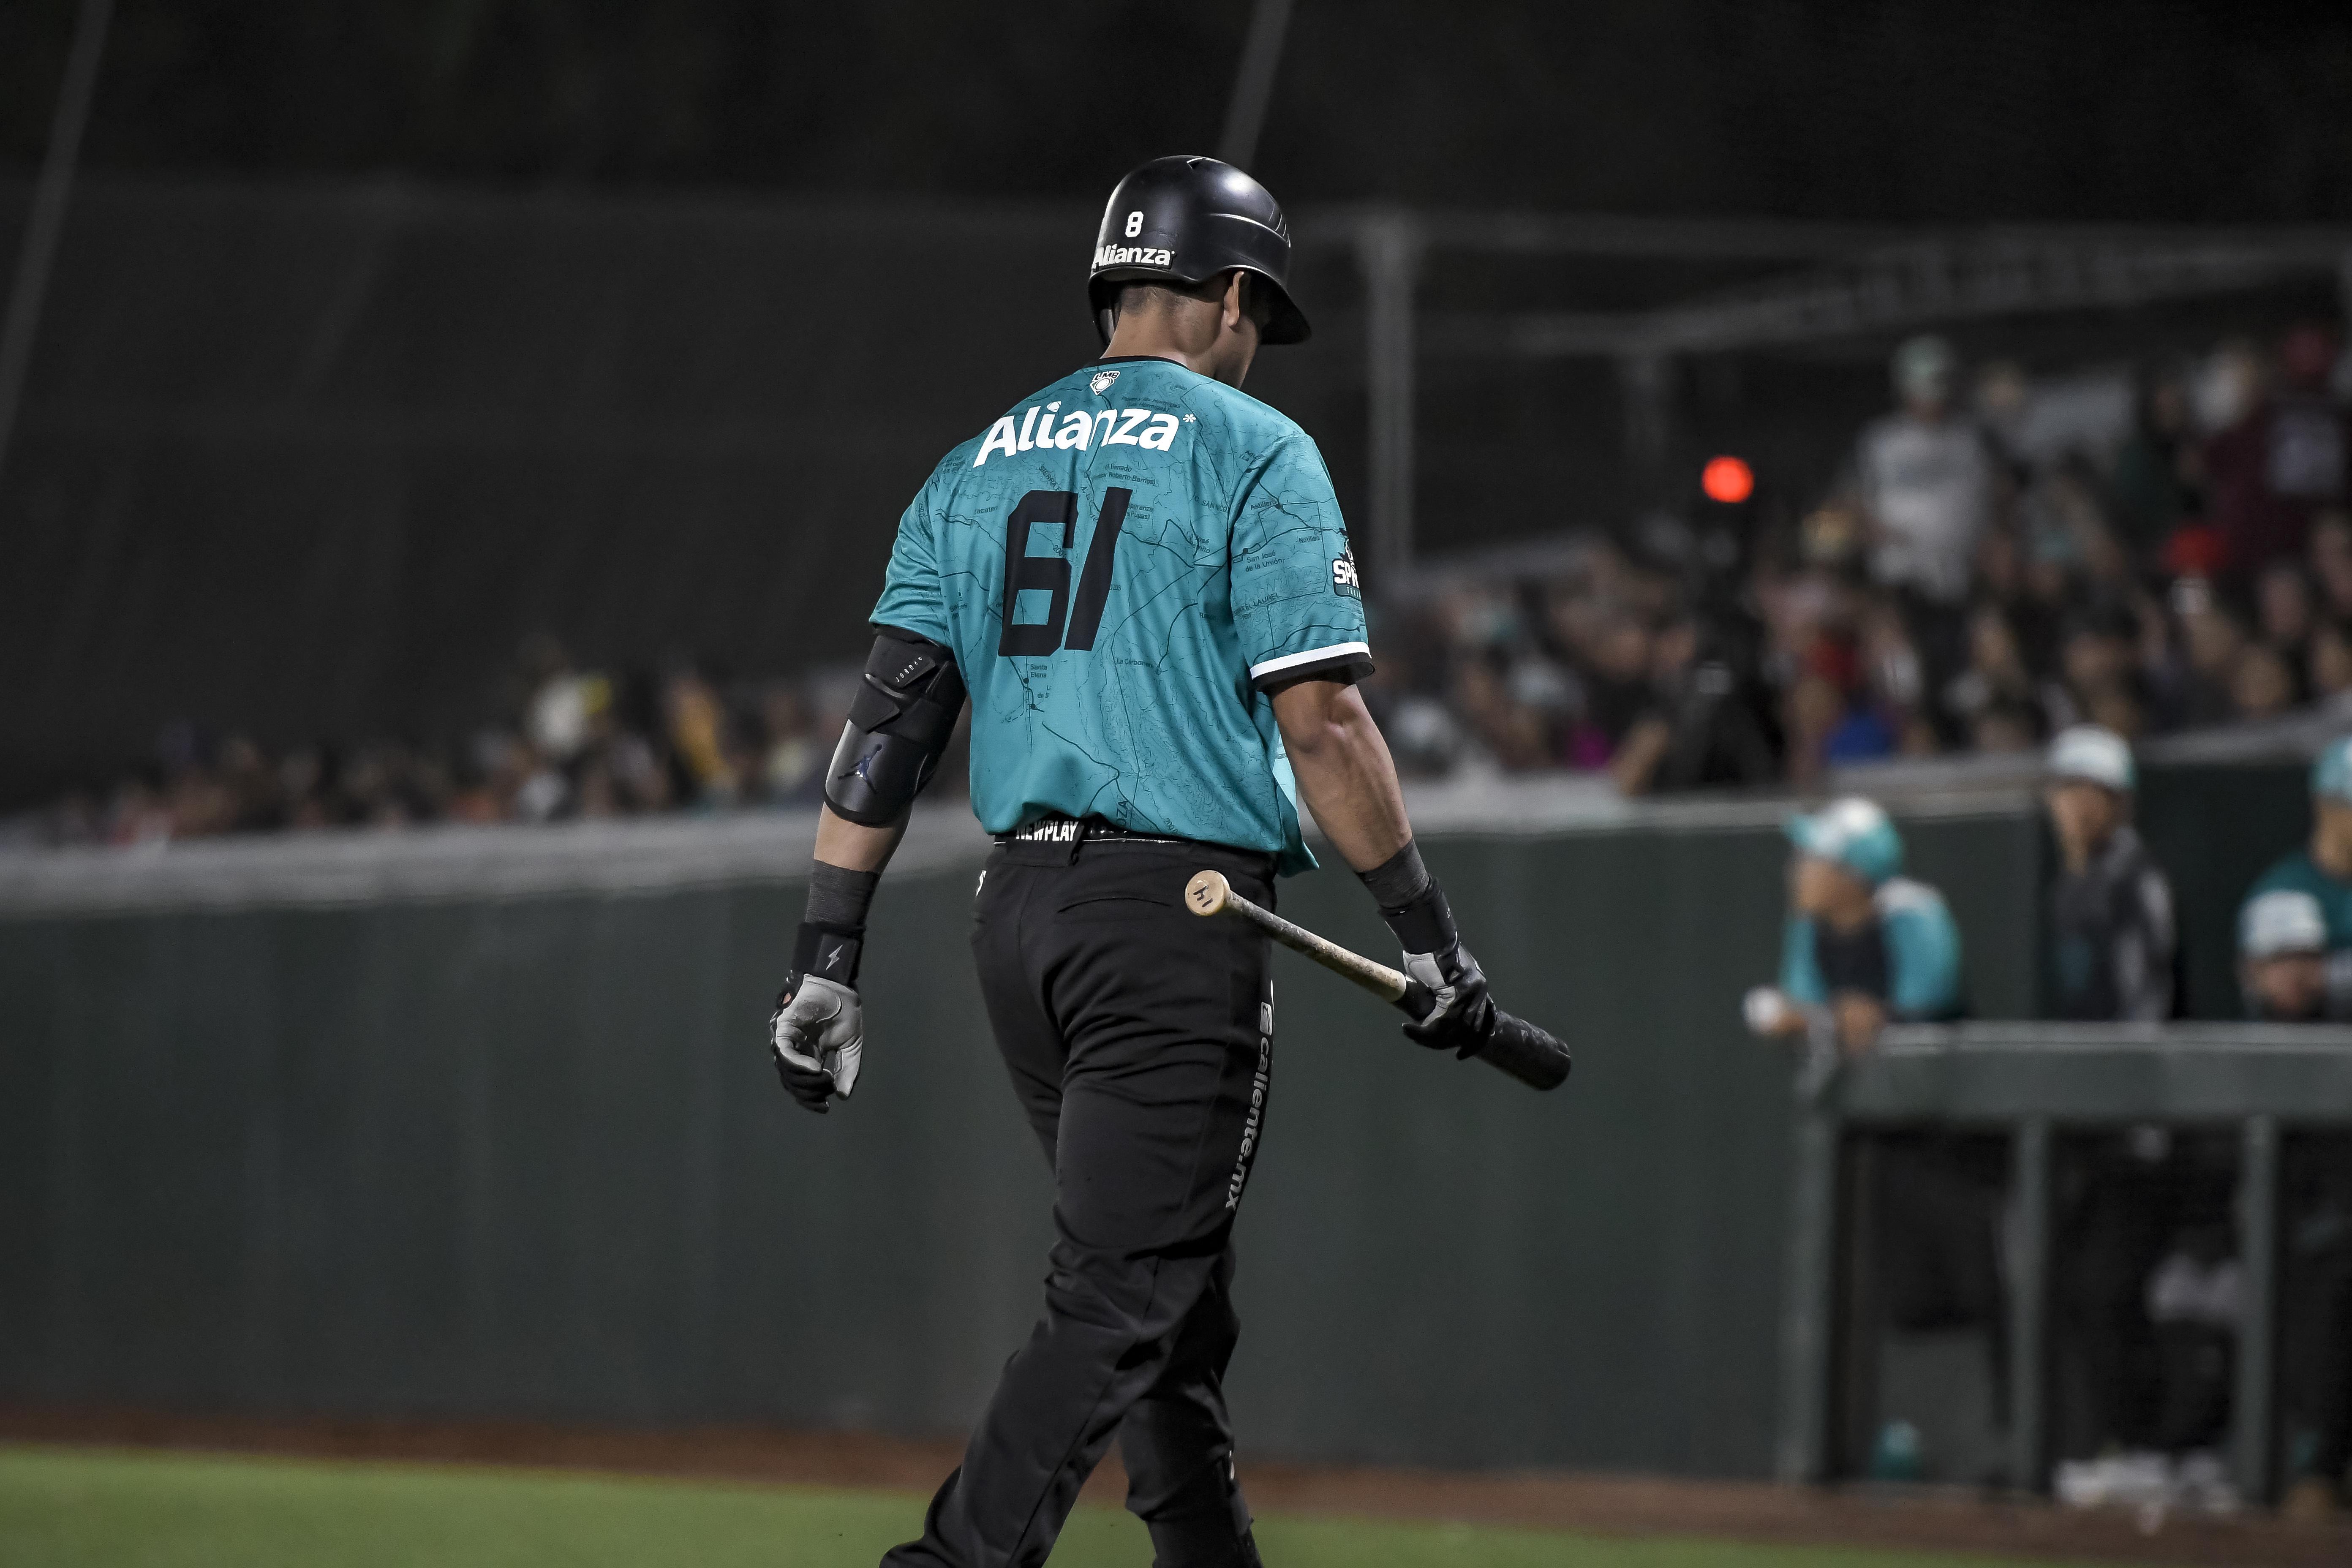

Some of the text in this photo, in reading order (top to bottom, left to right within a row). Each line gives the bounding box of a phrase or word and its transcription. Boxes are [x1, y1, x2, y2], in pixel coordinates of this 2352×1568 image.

[1125, 211, 1143, 237] 8
[1092, 244, 1171, 269] Alianza
[1093, 372, 1119, 381] LMB
[973, 401, 1180, 468] Alianza
[1262, 550, 1276, 560] José
[1262, 558, 1282, 567] Unión
[998, 486, 1134, 657] 61
[1016, 820, 1079, 841] NEWPLAY
[1225, 1037, 1269, 1211] caliente.mx
